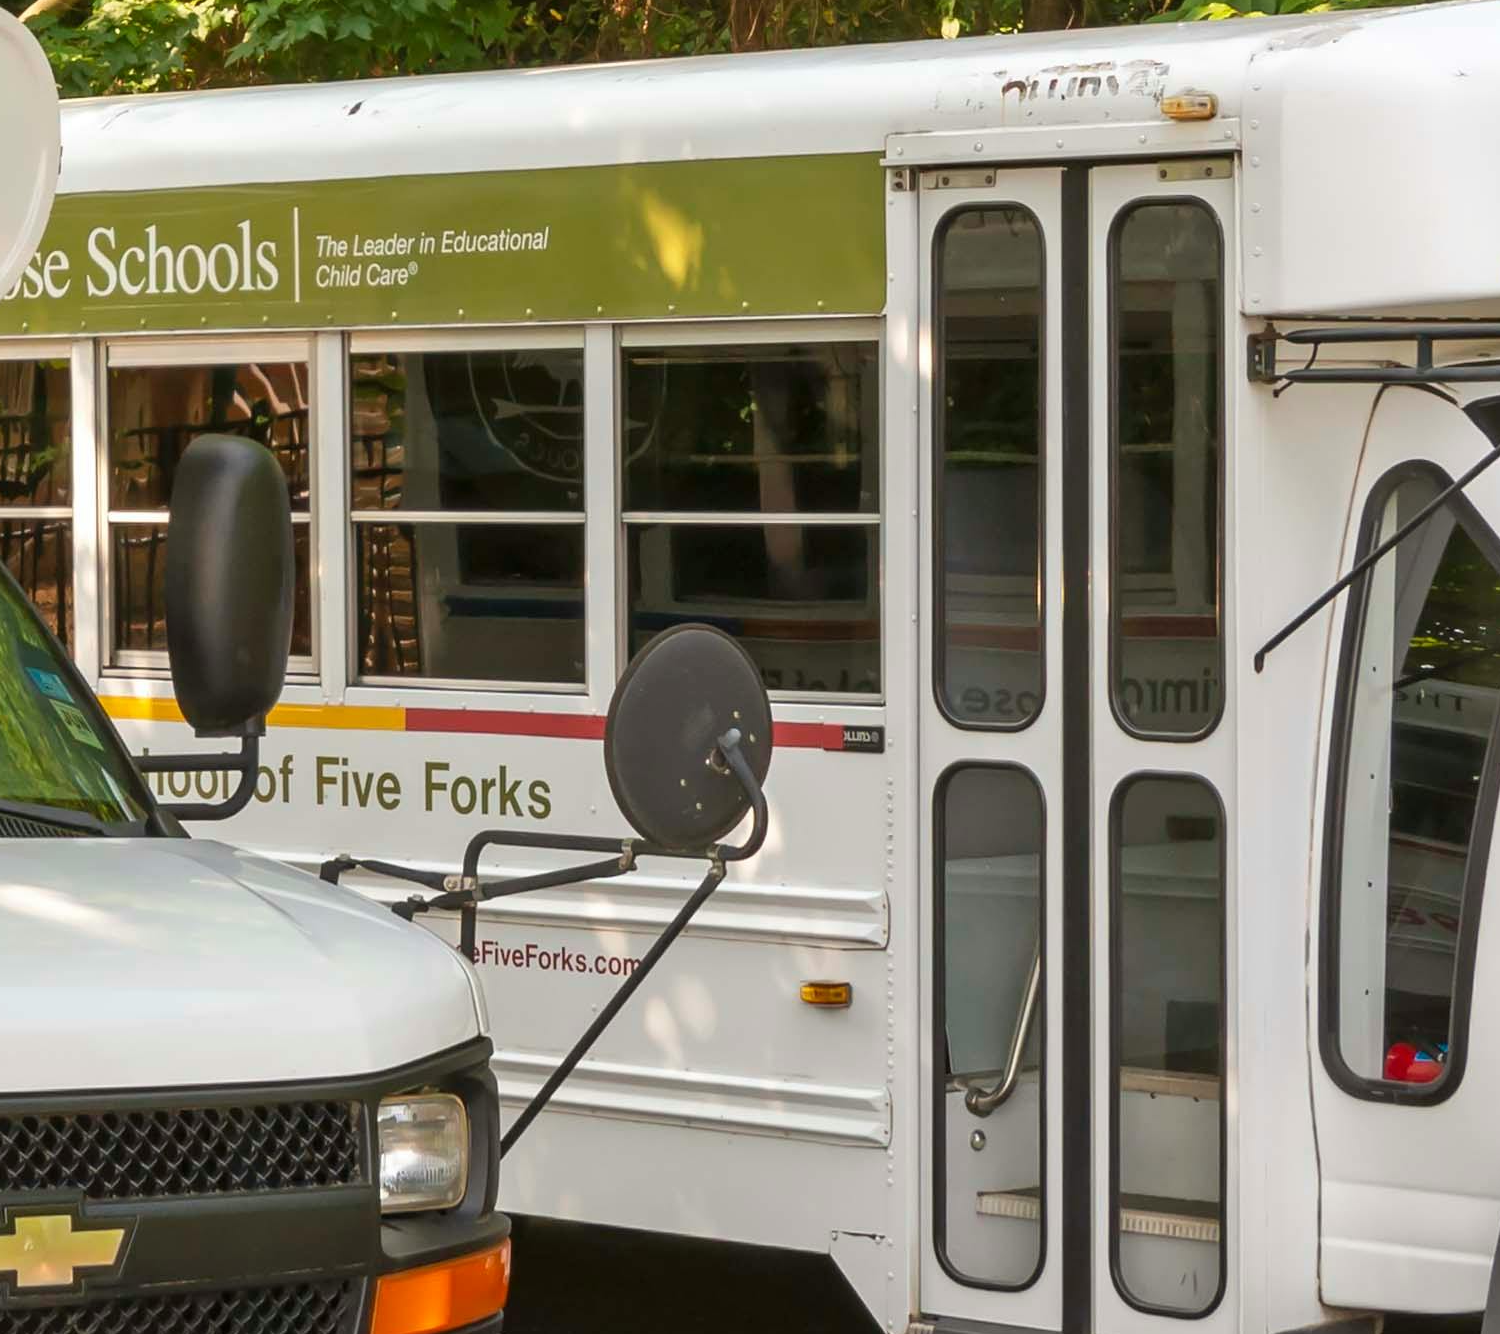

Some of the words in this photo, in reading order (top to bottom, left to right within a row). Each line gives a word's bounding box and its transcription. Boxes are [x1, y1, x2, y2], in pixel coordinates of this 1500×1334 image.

[86, 219, 279, 297] Schools
[316, 234, 348, 257] The
[353, 233, 415, 257] Leader
[419, 232, 436, 254] in
[441, 226, 549, 254] Educational
[316, 264, 361, 288] Child
[253, 755, 294, 804] of
[315, 756, 401, 811] Five
[424, 761, 552, 820] Forks
